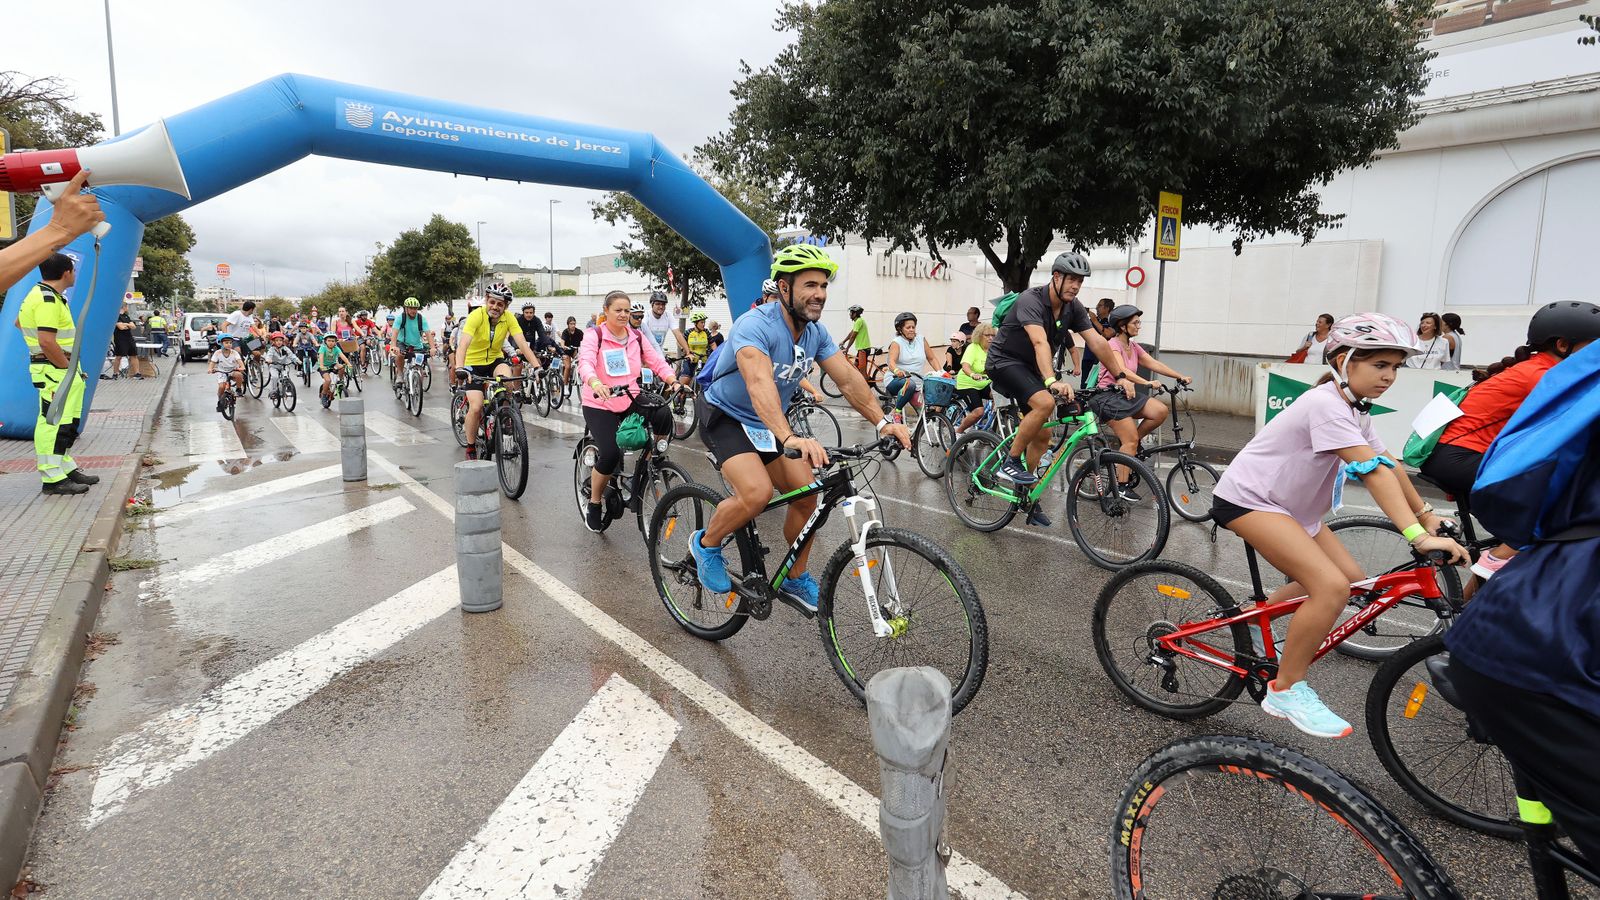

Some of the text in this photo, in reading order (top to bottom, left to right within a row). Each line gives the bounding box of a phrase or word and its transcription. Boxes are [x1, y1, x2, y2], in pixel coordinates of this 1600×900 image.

[382, 110, 622, 154] Ayuntamiento de Jerez
[382, 122, 460, 142] Deportes
[791, 503, 827, 550] TREK
[1120, 780, 1154, 847] MAXXIS
